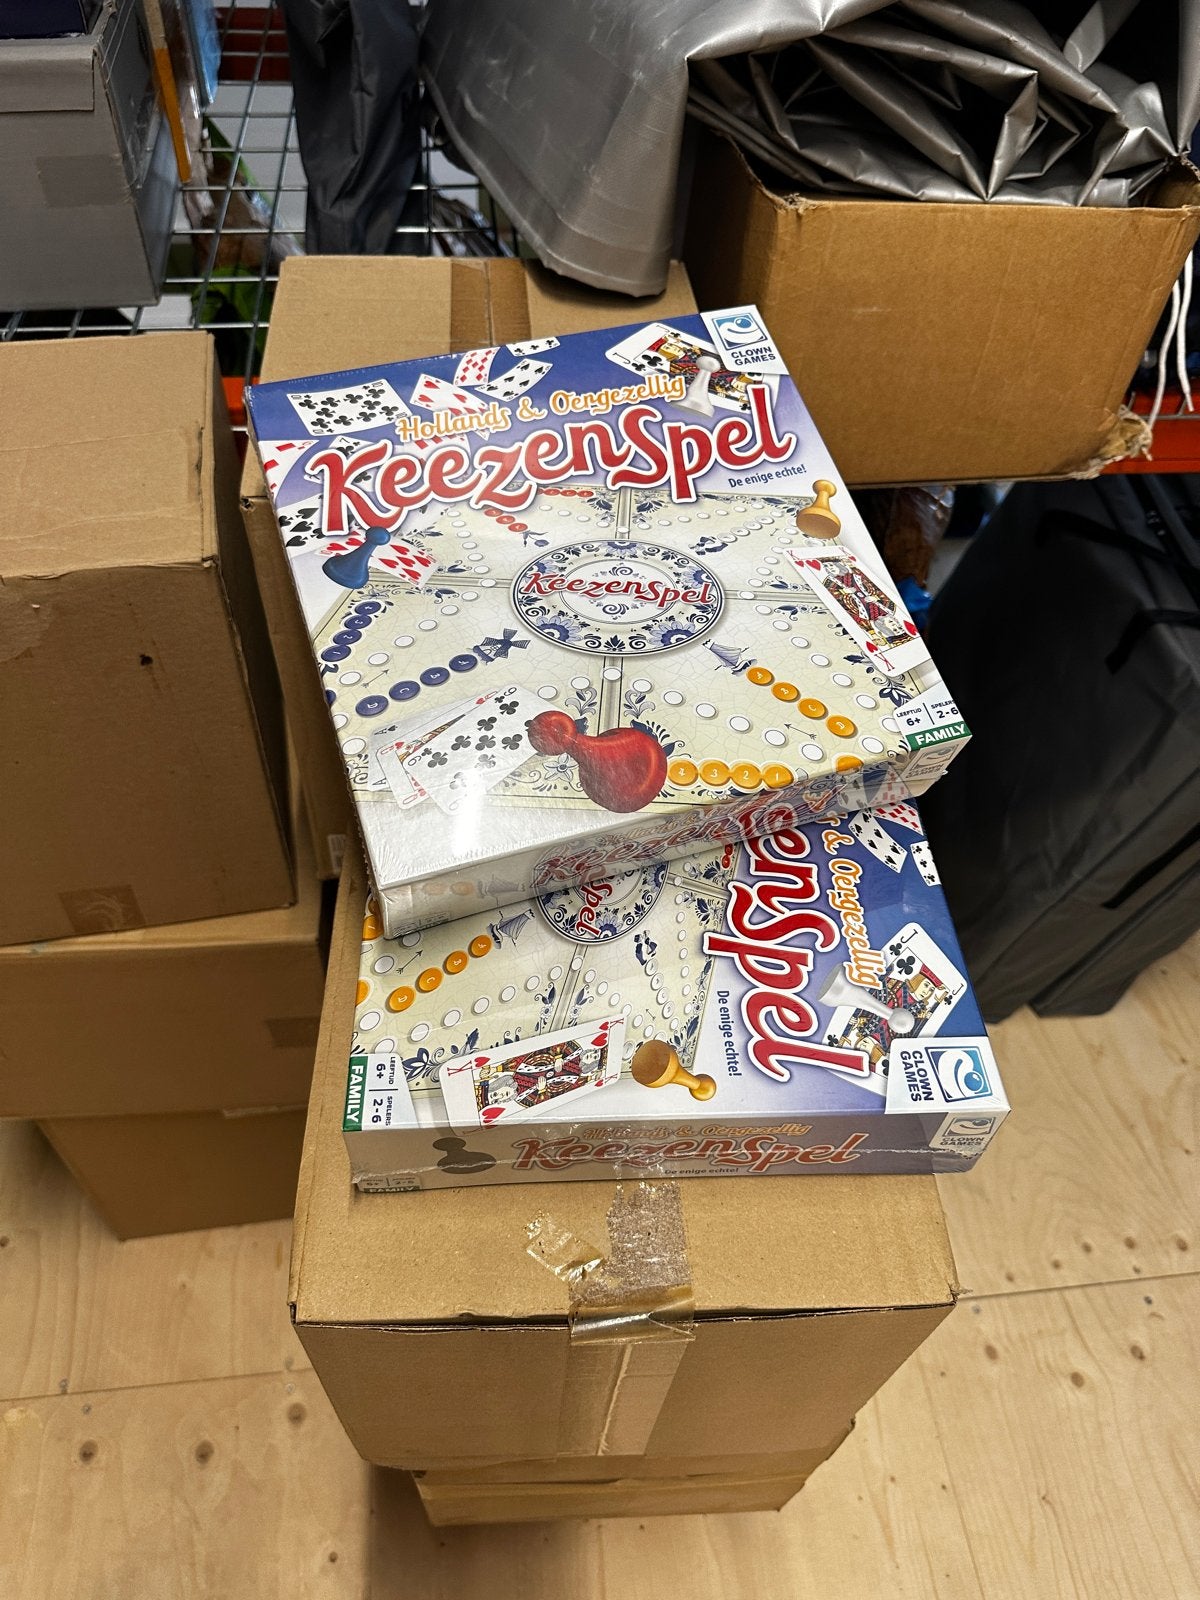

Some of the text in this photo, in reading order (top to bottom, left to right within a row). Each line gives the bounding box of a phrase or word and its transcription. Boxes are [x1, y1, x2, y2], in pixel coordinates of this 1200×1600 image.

[731, 346, 773, 360] CLOWN
[734, 353, 776, 367] GAMES
[398, 403, 511, 441] Hollands
[518, 397, 546, 421] &
[728, 464, 807, 488] De enige echte!
[520, 572, 715, 609] KeezenSpel
[906, 716, 921, 727] 6+
[914, 723, 966, 746] FAMILY
[743, 770, 749, 780] 2
[717, 990, 742, 1077] De enige echte!
[376, 1063, 386, 1079] 6+
[900, 1050, 922, 1102] GAMES
[912, 1050, 935, 1101] CLOWN
[346, 1065, 364, 1123] FAMILY
[385, 1096, 393, 1126] SPELERS
